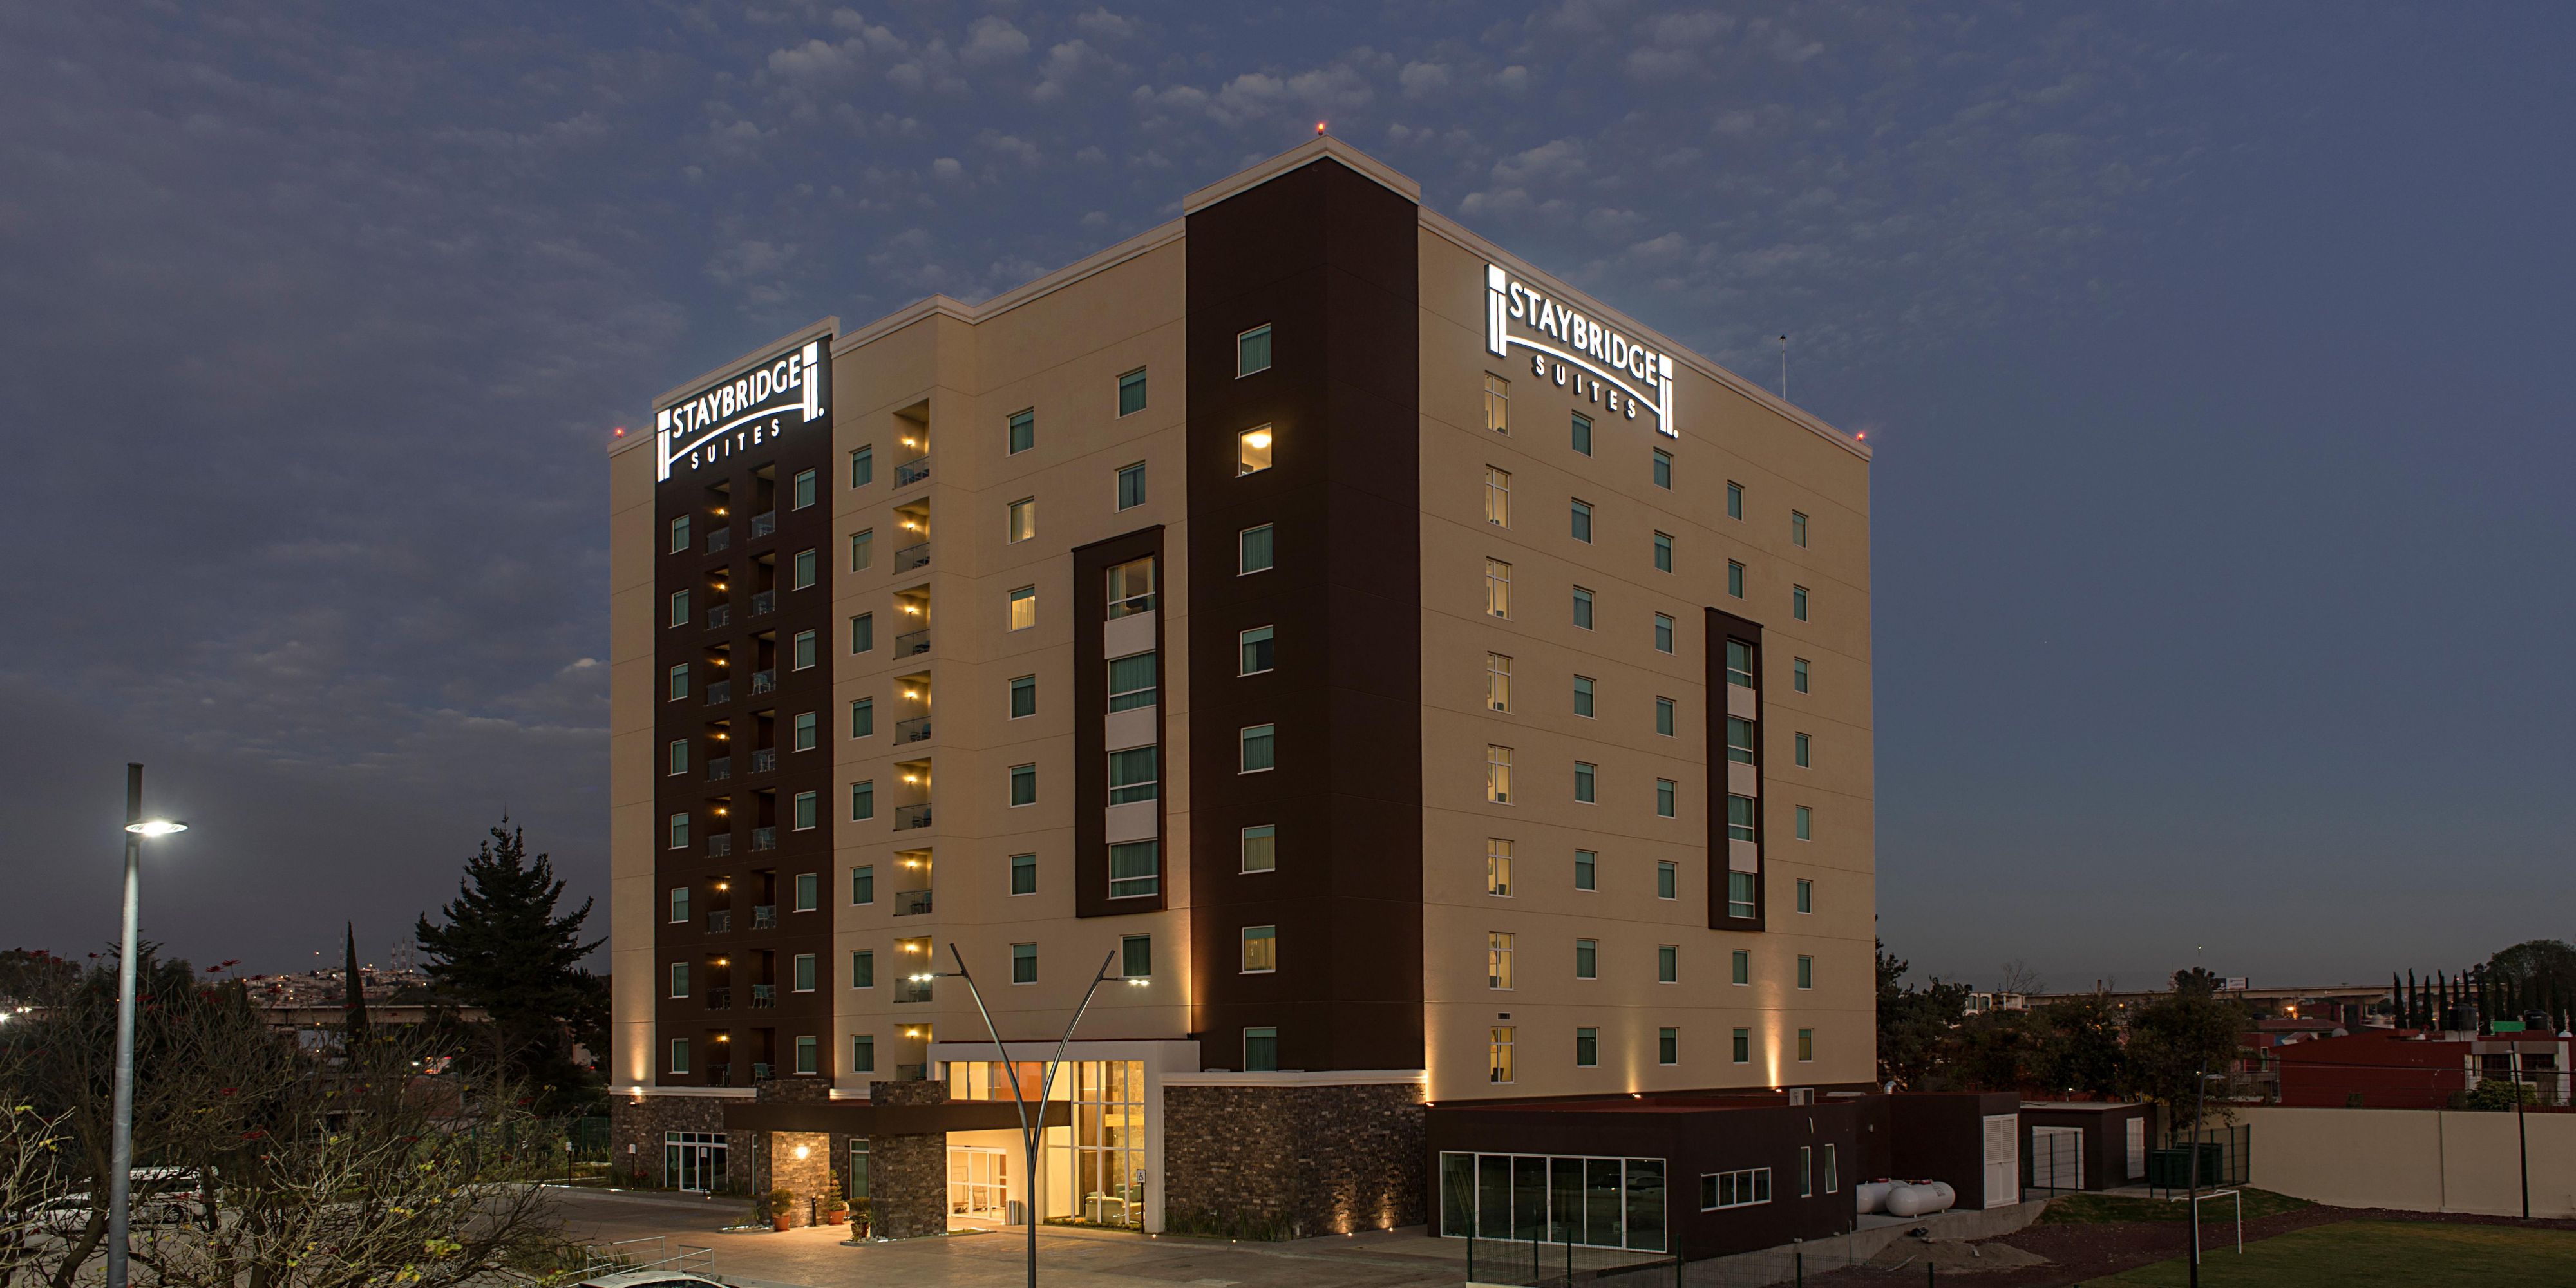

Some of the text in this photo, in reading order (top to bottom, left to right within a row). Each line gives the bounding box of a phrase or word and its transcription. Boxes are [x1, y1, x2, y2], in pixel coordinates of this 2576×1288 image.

[1510, 281, 1658, 386] STAYBRIDGE
[672, 354, 801, 439] STAYBRIDGE
[1535, 355, 1636, 419] SUITES
[691, 419, 779, 469] SUITES
